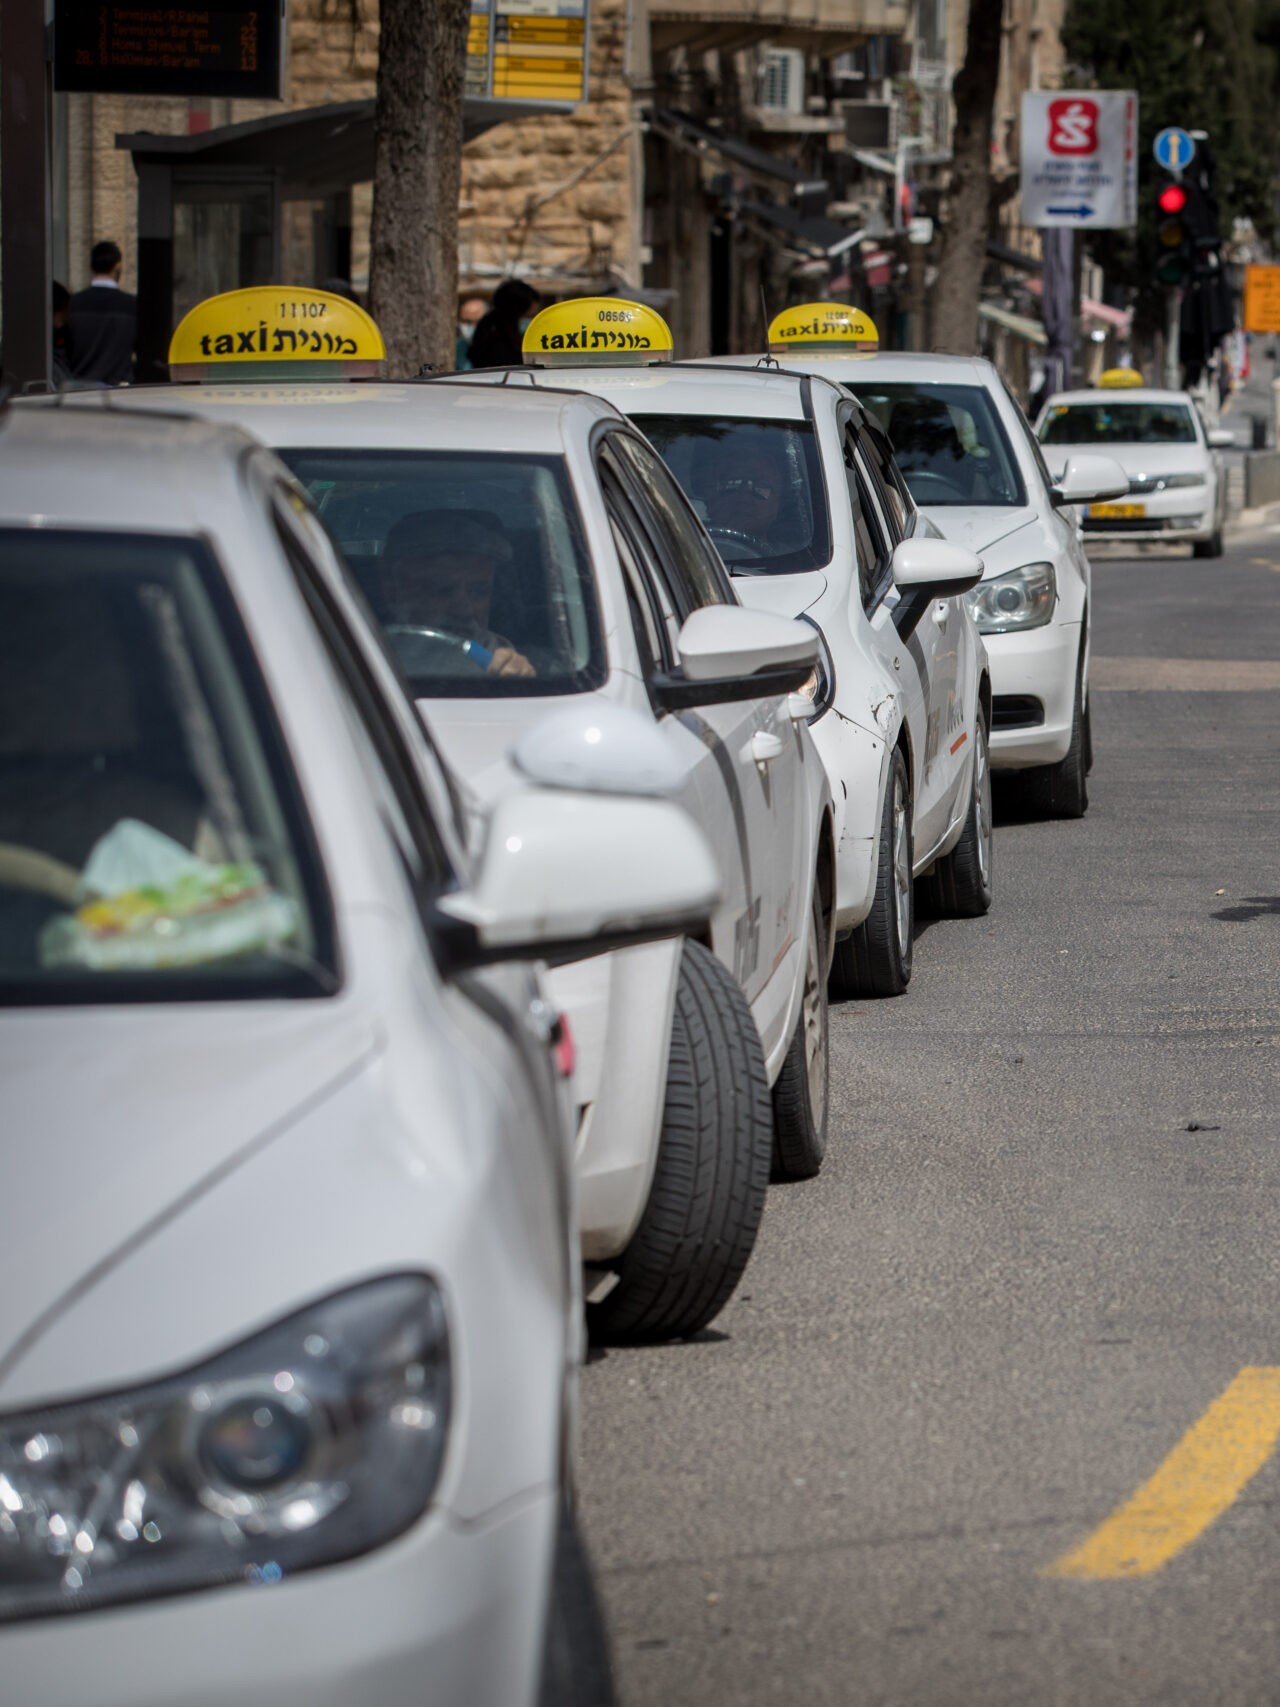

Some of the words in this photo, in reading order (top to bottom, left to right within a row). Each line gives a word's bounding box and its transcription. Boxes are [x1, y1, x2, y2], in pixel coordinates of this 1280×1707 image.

[280, 302, 326, 318] 11107
[200, 321, 268, 356] taxi
[272, 328, 358, 355] מונית
[540, 325, 588, 349] taxi
[591, 330, 651, 349] מונית
[779, 318, 819, 338] taxi
[821, 321, 865, 335] מונית
